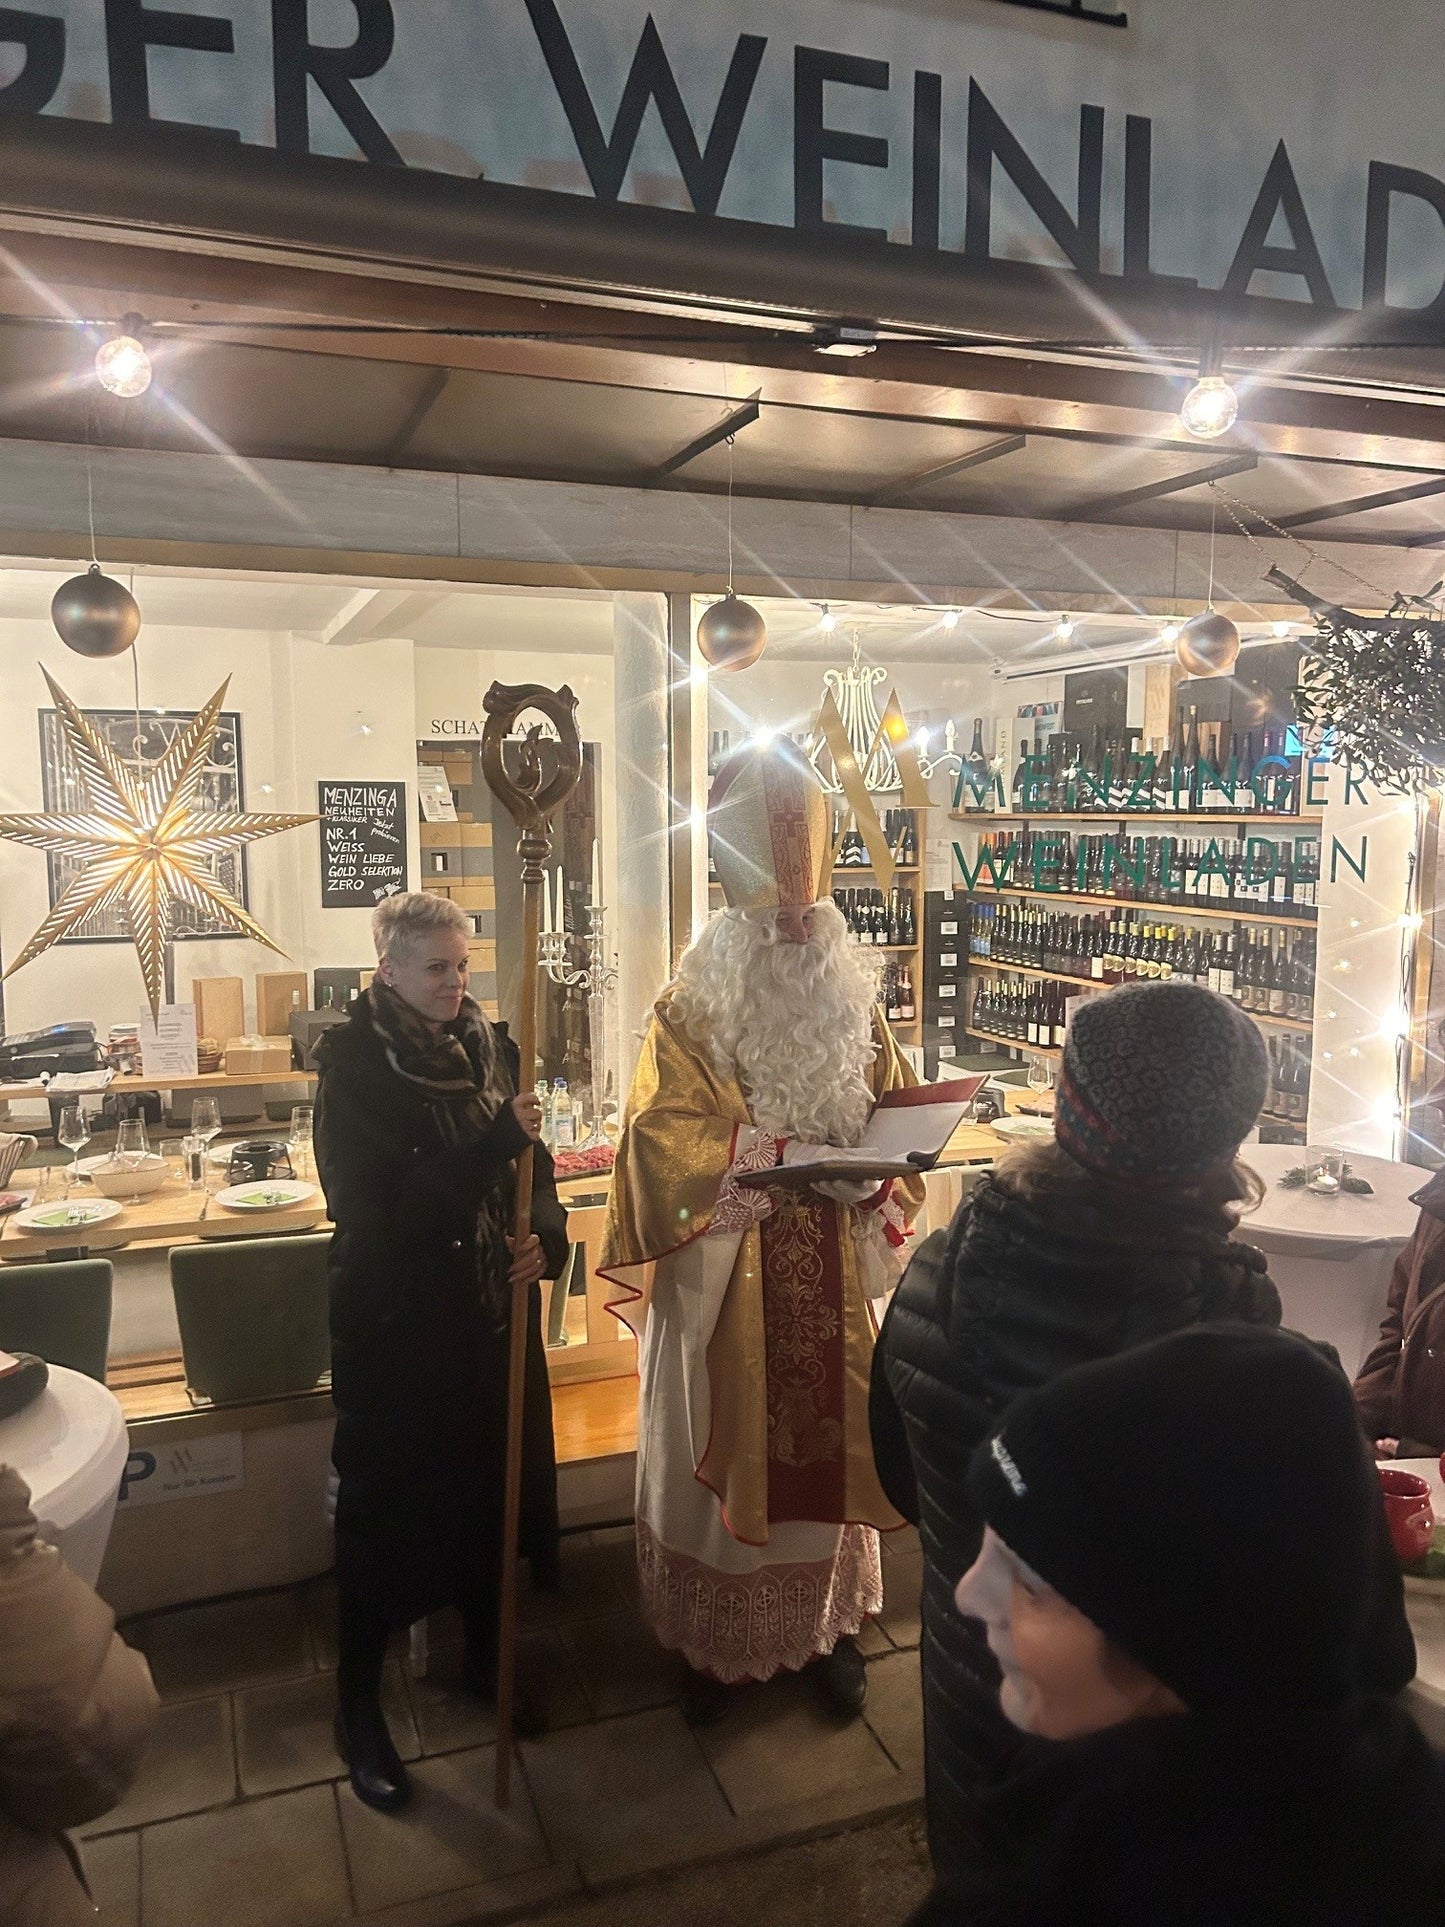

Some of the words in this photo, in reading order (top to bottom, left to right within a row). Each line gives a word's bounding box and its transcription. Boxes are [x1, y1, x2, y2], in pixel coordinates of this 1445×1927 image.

[952, 752, 1369, 809] MENZINGER
[324, 787, 397, 808] MENZINGA
[325, 806, 395, 817] NEUHEITEN
[327, 840, 365, 853] WEISS
[328, 853, 357, 864] WEIN
[363, 854, 395, 864] LIEBE
[952, 834, 1367, 893] WEINLADEN
[328, 865, 357, 878] GOLD
[327, 879, 365, 892] ZERO
